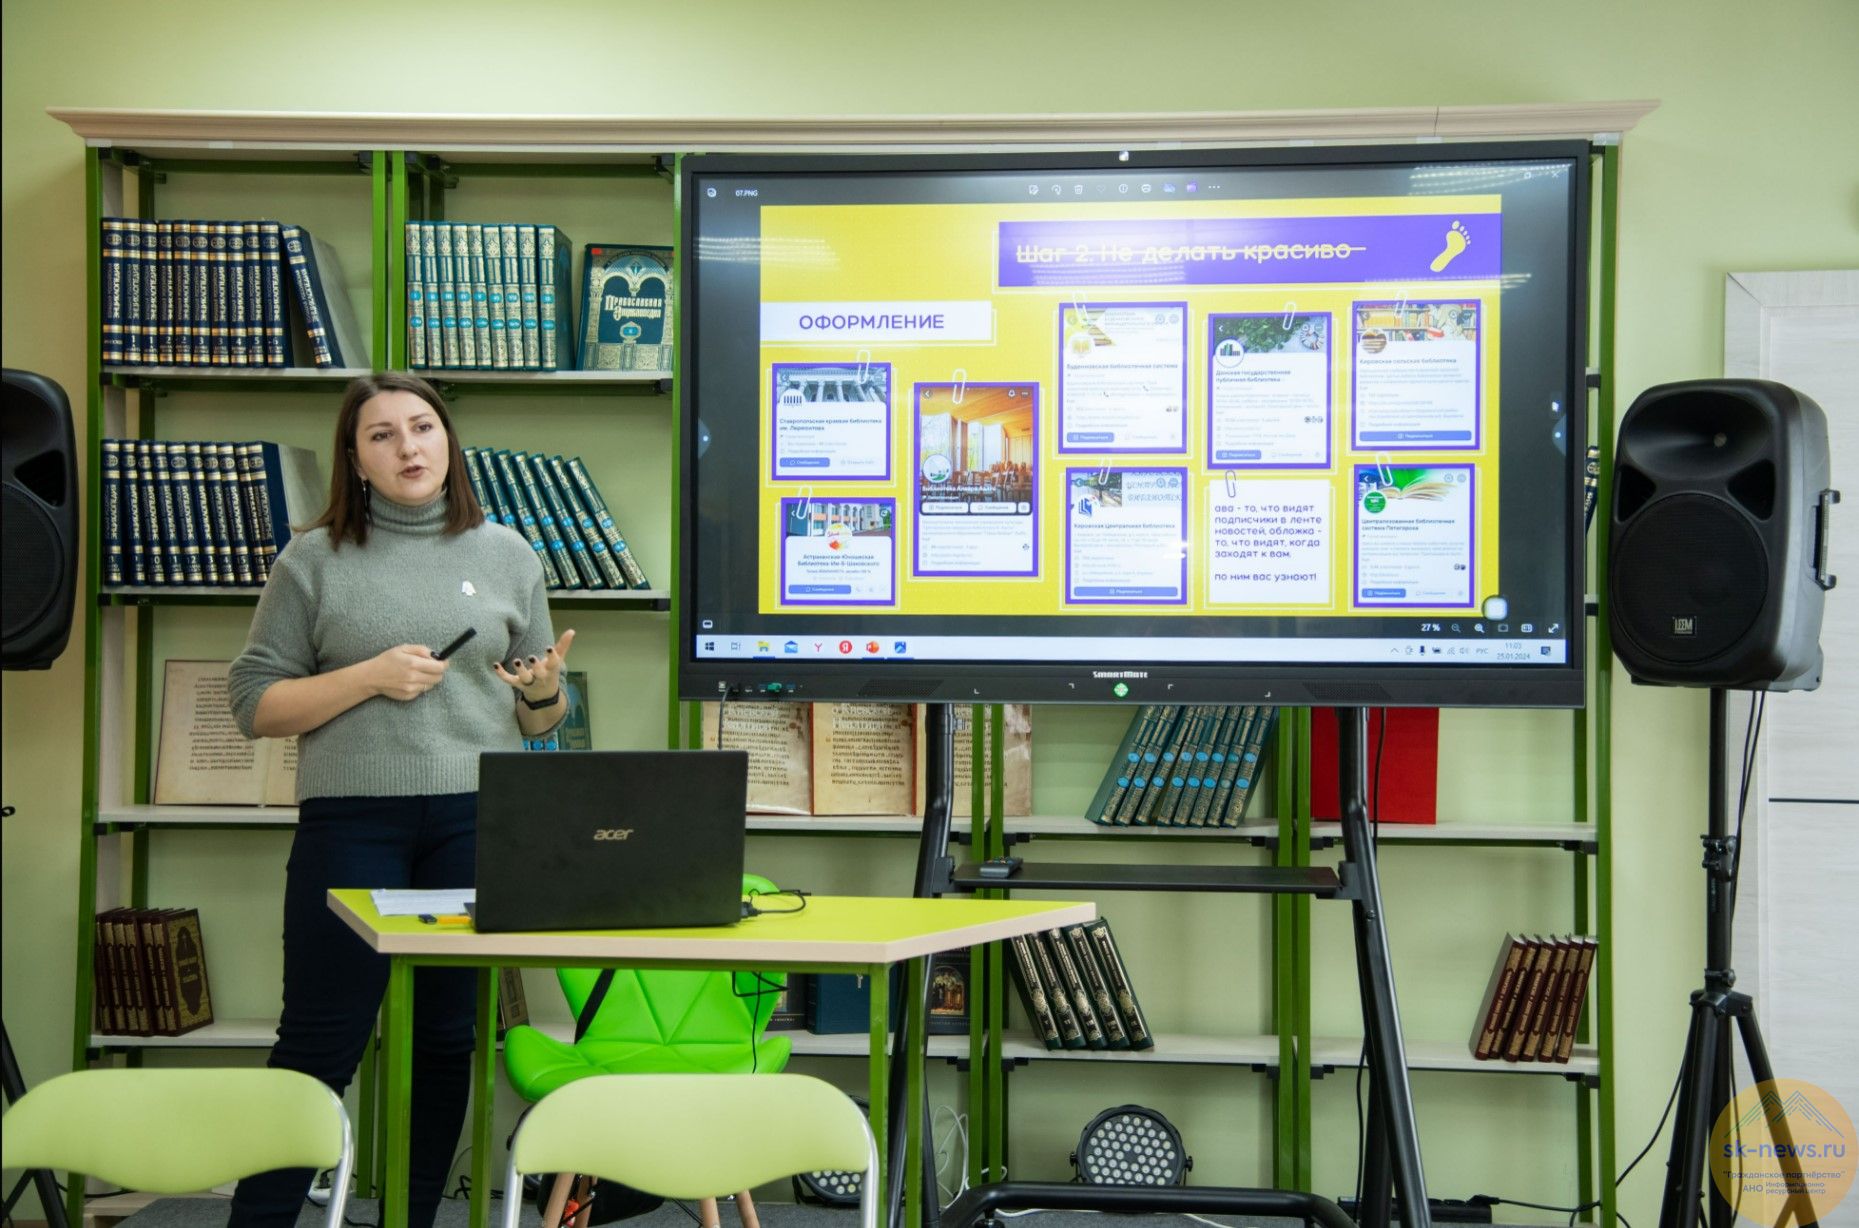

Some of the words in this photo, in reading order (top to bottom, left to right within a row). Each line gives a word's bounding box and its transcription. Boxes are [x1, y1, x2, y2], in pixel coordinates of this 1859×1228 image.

[1016, 244, 1064, 263] Шаг
[1101, 243, 1133, 262] Не
[1142, 243, 1237, 265] делать
[1244, 243, 1351, 264] красиво
[799, 314, 945, 331] ОФОРМЛЕНИЕ
[1245, 505, 1258, 513] то,
[1282, 505, 1314, 513] видят
[1215, 517, 1278, 525] подписчики
[1290, 516, 1322, 524] ленте
[1268, 526, 1315, 535] обложка
[1289, 539, 1320, 548] когда
[1215, 550, 1258, 558] заходят
[1274, 573, 1317, 582] узнают!
[1421, 624, 1431, 632] 27
[593, 829, 634, 841] acer
